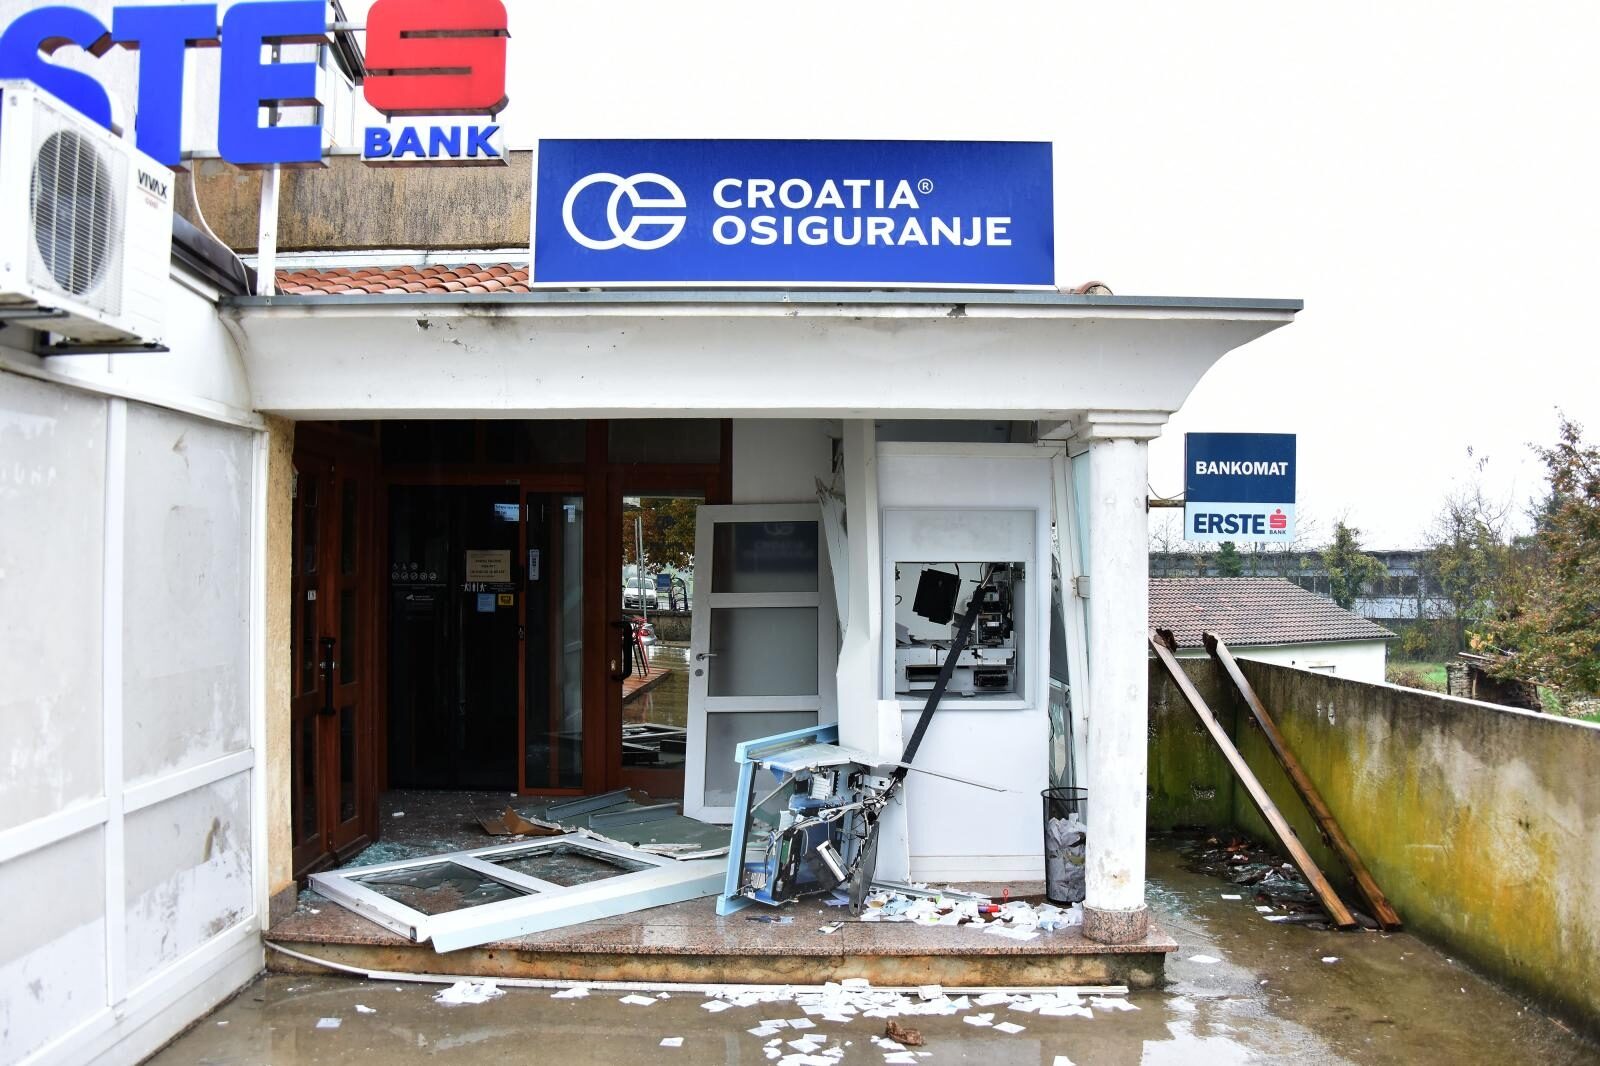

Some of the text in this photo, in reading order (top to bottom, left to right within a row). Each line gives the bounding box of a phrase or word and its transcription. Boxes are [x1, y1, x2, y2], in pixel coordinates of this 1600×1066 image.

[364, 125, 501, 158] BANK
[138, 168, 167, 199] VIVAX
[712, 215, 1012, 246] OSIGURANJE
[1195, 461, 1289, 476] BANKOMAT
[1193, 513, 1266, 535] ERSTE
